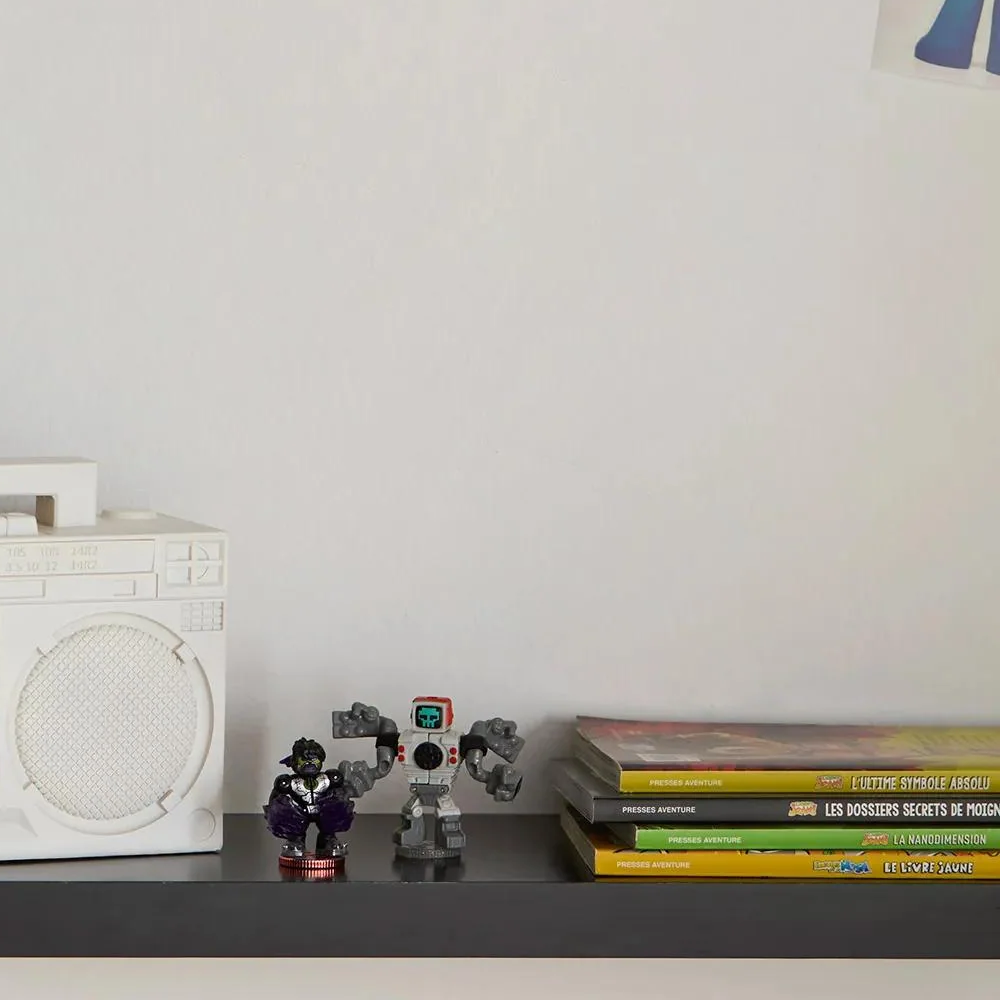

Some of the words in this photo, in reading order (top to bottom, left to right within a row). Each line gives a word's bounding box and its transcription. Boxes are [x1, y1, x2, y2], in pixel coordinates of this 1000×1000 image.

[649, 779, 684, 787] PRESSES
[685, 779, 723, 787] AVENTURE
[850, 775, 898, 791] L'ULTIME
[900, 775, 947, 791] SYMBOLE
[949, 775, 991, 791] ABSOLU
[622, 806, 657, 814] PRESSES
[657, 806, 697, 814] AVENTURE
[825, 803, 844, 817] LES
[847, 803, 900, 817] DOSSIERS
[902, 803, 948, 817] SECRETS
[951, 803, 964, 817] DE
[668, 836, 703, 844] PRESSES
[703, 836, 743, 844] AVENTURE
[893, 834, 906, 845] LA
[908, 834, 987, 845] NANODIMENSION
[616, 861, 651, 869] PRESSES
[651, 861, 691, 869] AVENTURE
[884, 861, 898, 874] LE
